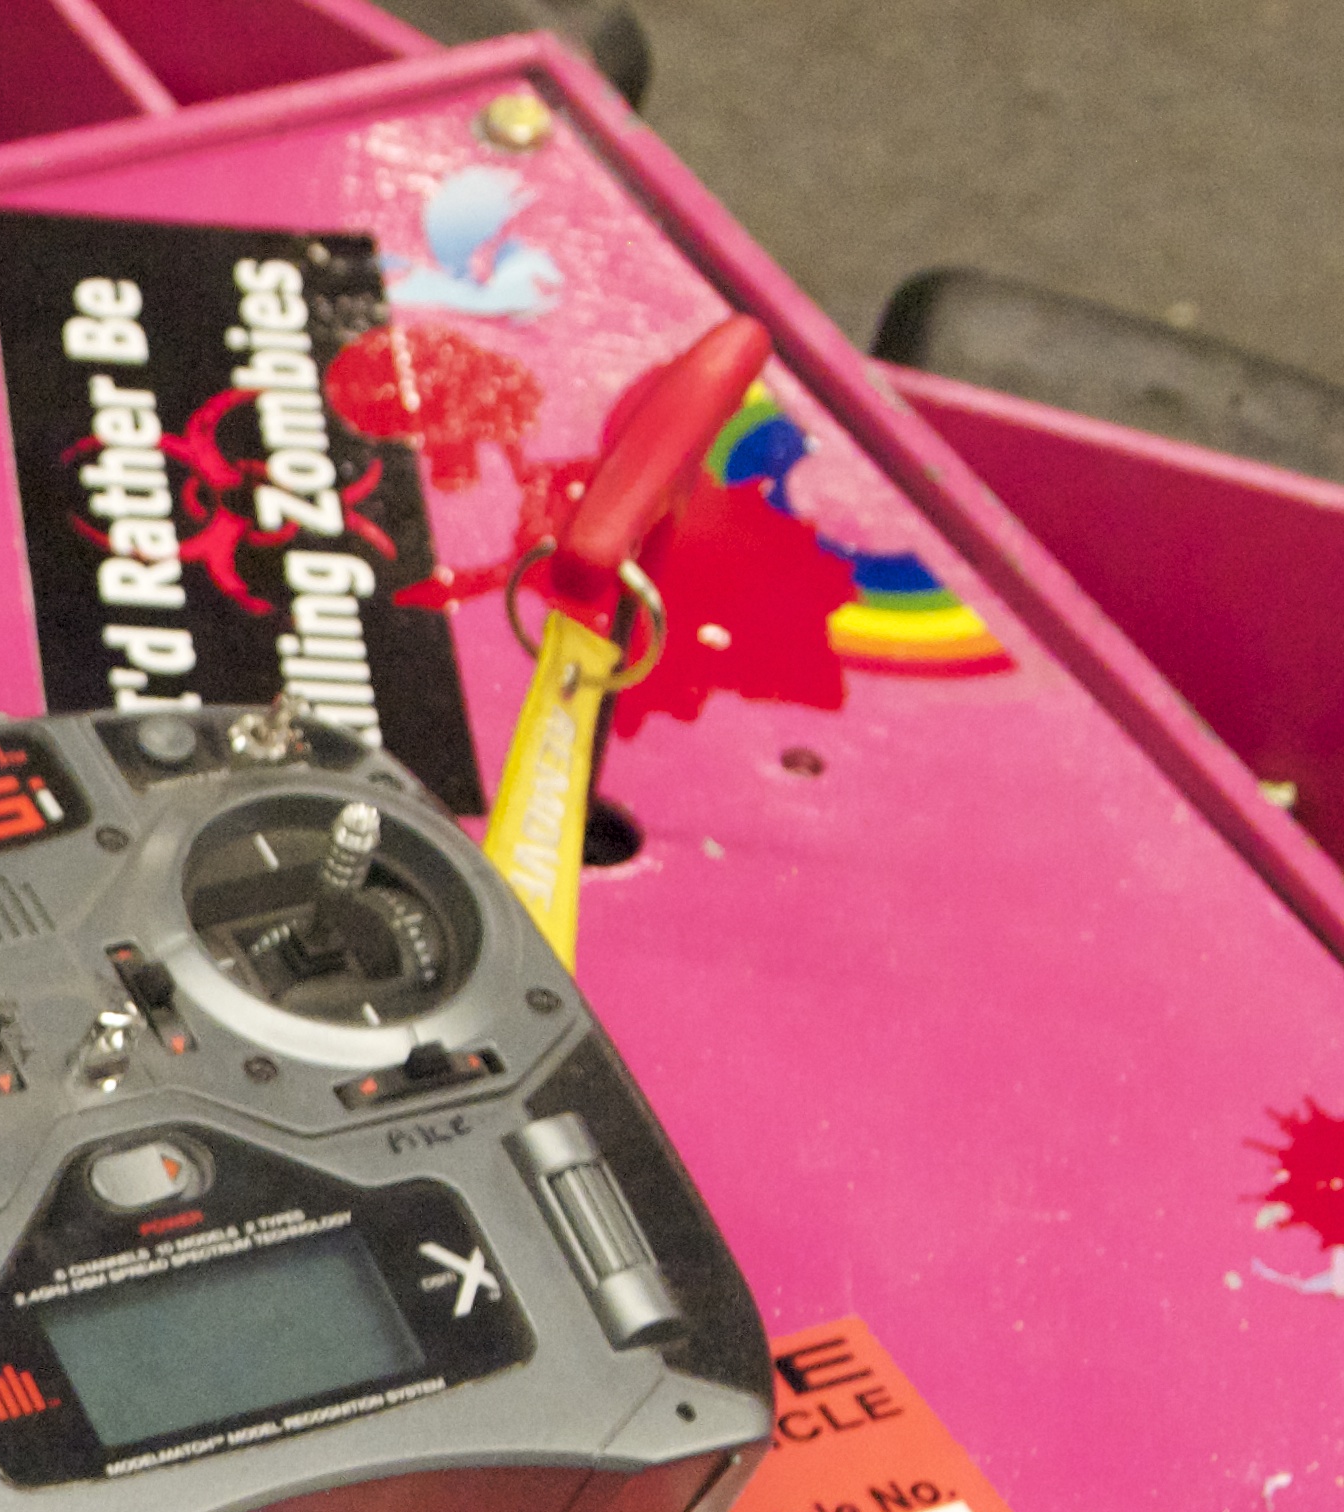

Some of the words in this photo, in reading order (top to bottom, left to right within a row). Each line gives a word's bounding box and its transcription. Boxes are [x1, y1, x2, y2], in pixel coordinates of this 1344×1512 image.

[63, 276, 150, 363] Be
[226, 257, 345, 536] Zombies
[81, 374, 188, 607] Rather
